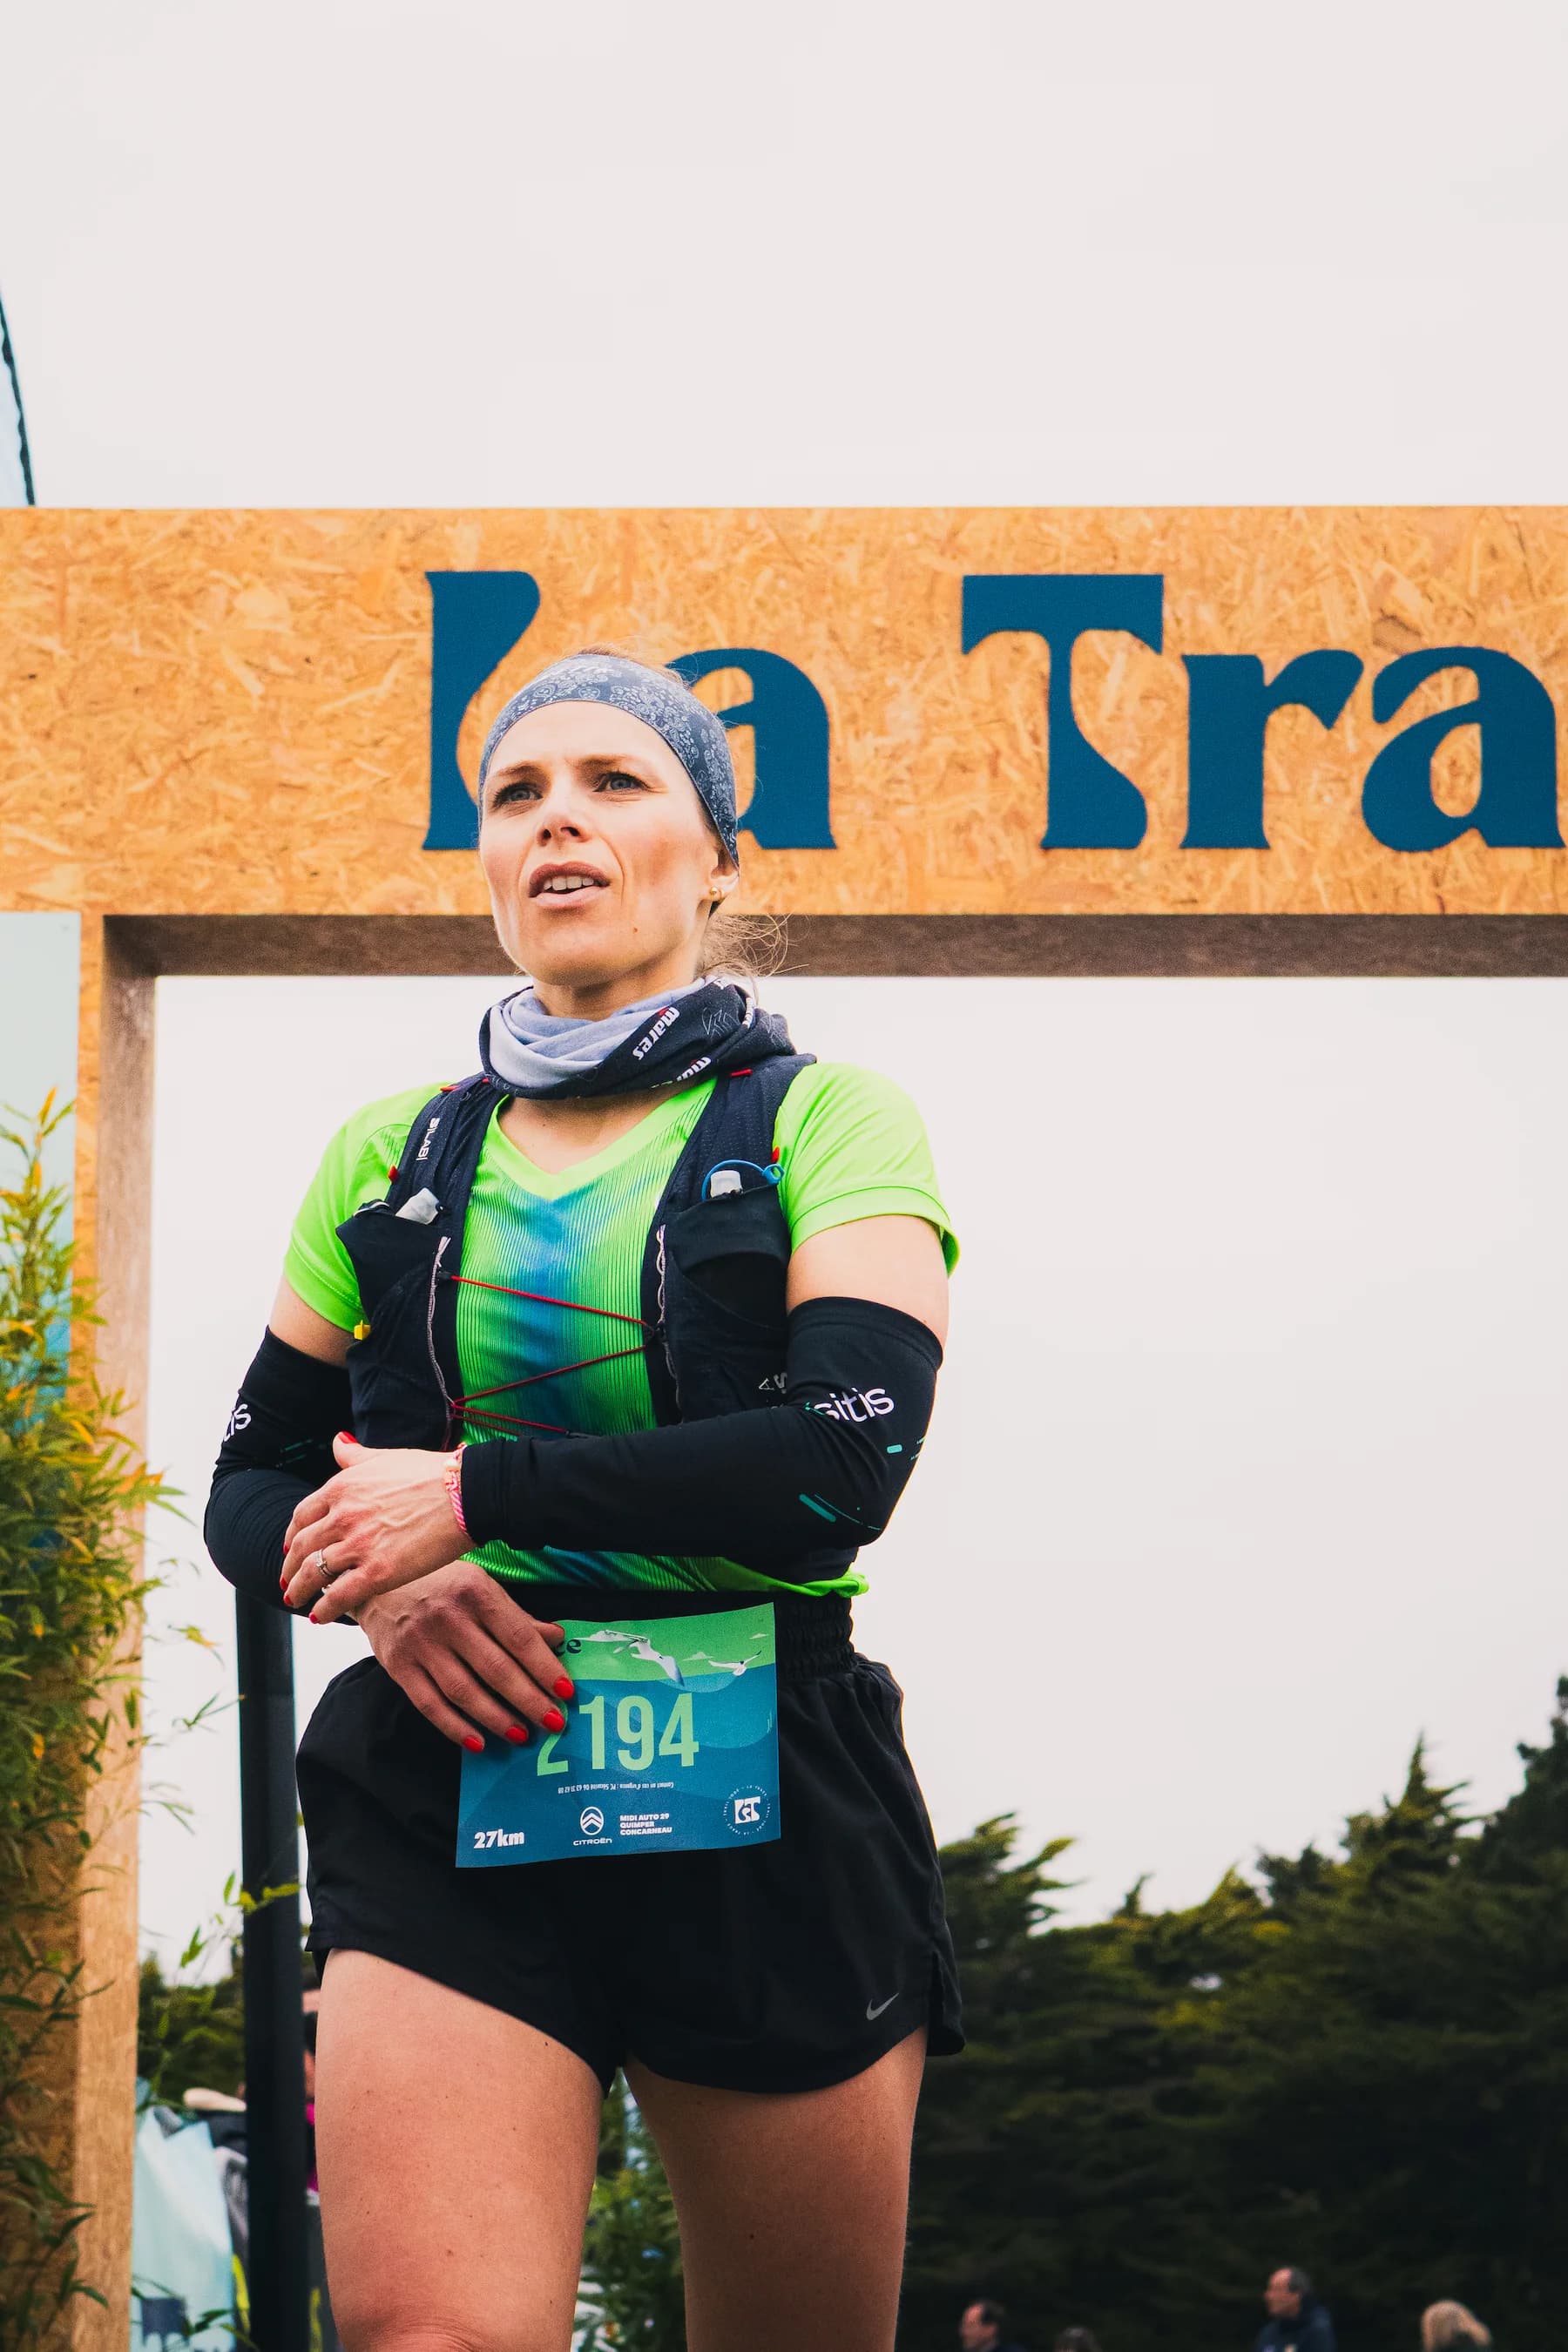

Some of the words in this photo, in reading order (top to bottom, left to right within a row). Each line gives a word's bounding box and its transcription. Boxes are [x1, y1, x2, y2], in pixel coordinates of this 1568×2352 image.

[962, 573, 1566, 853] Tra
[632, 1006, 680, 1061] mares
[537, 1692, 700, 1777] 2194
[474, 1829, 525, 1849] 27km
[619, 1827, 672, 1835] CONCARNEAU
